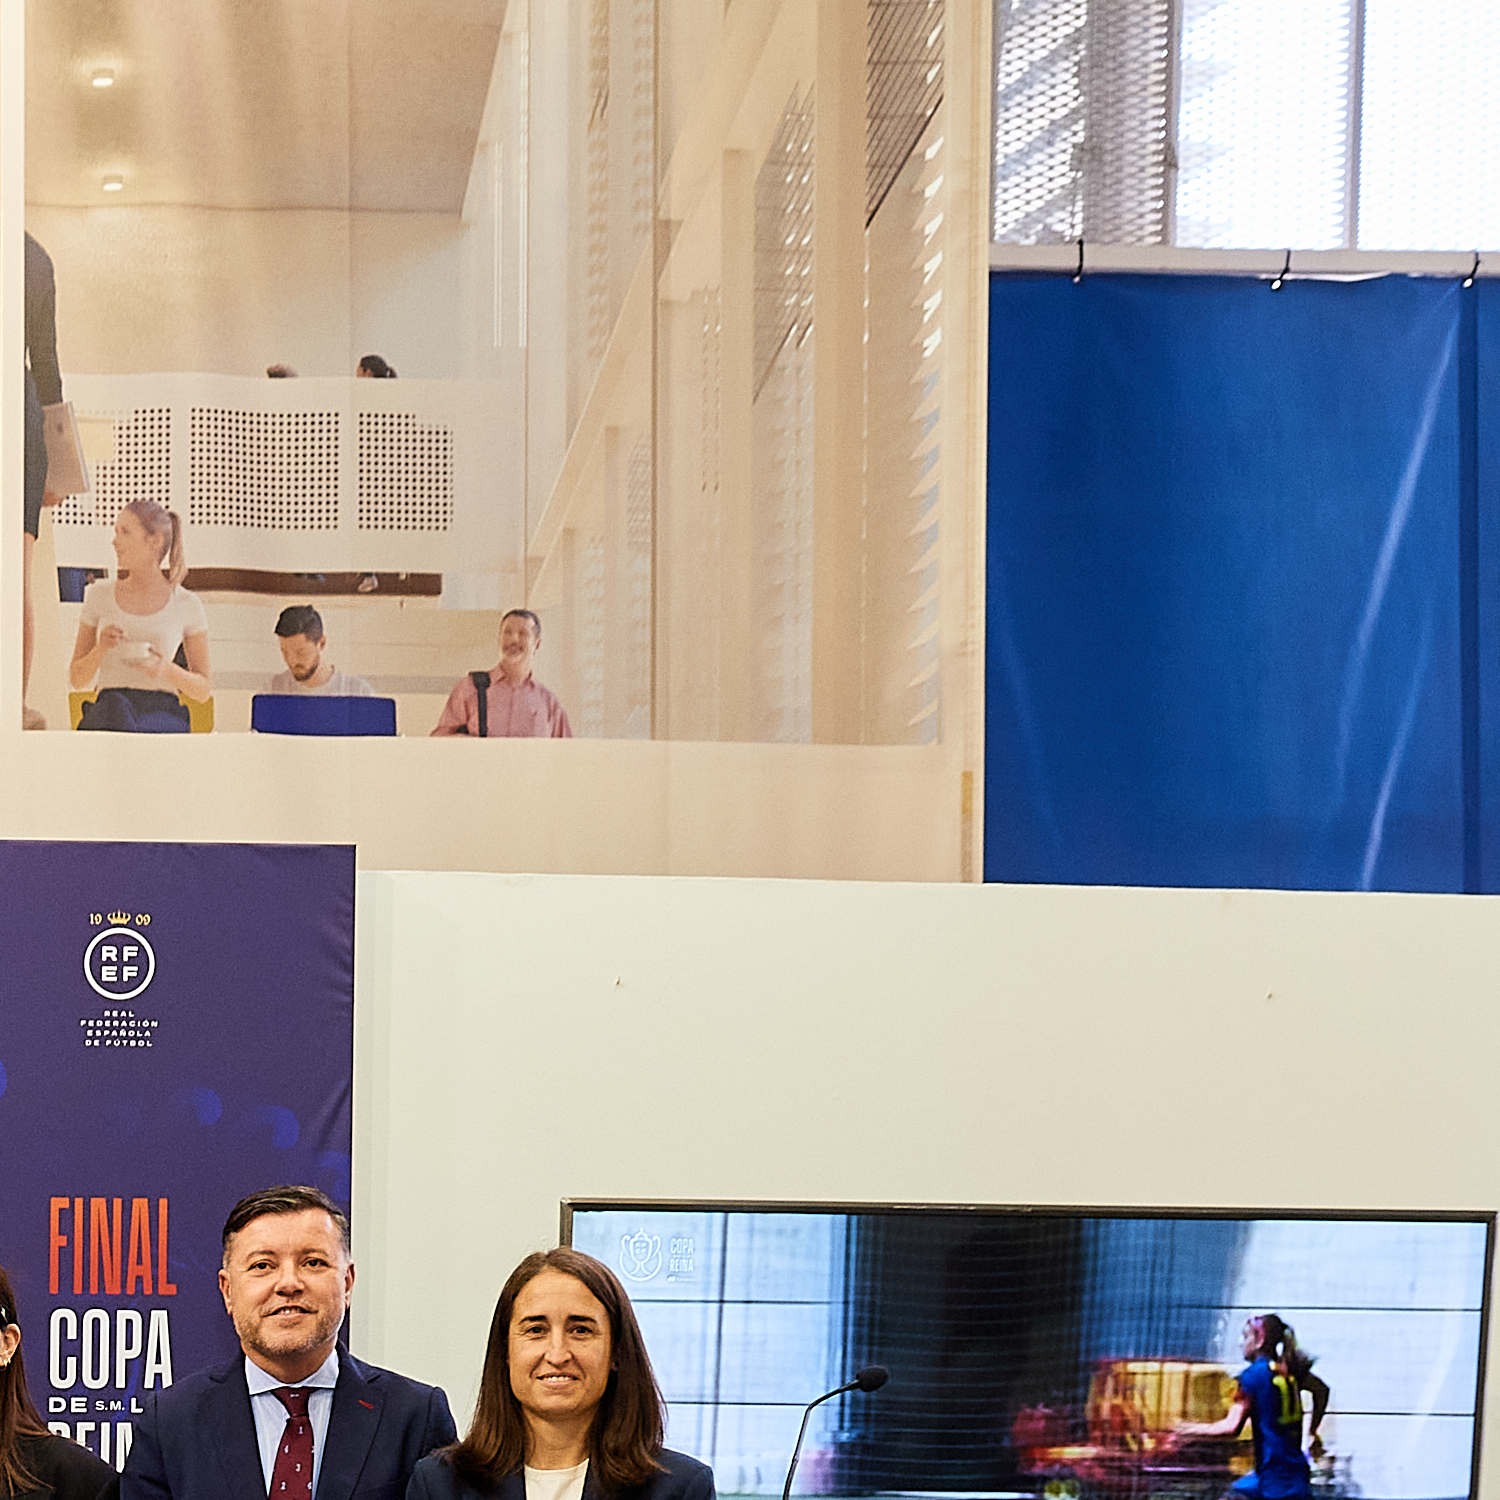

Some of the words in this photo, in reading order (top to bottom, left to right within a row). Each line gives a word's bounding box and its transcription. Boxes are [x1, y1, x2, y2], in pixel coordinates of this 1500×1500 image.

[89, 912, 102, 925] 19
[80, 1019, 159, 1028] FEDERACIÓN
[86, 1029, 151, 1037] ESPAÑOLA
[85, 1039, 100, 1047] DE
[49, 1196, 178, 1295] FINAL
[49, 1308, 173, 1390] COPA
[48, 1396, 88, 1413] DE
[95, 1400, 125, 1411] S.M.
[130, 1397, 144, 1414] L
